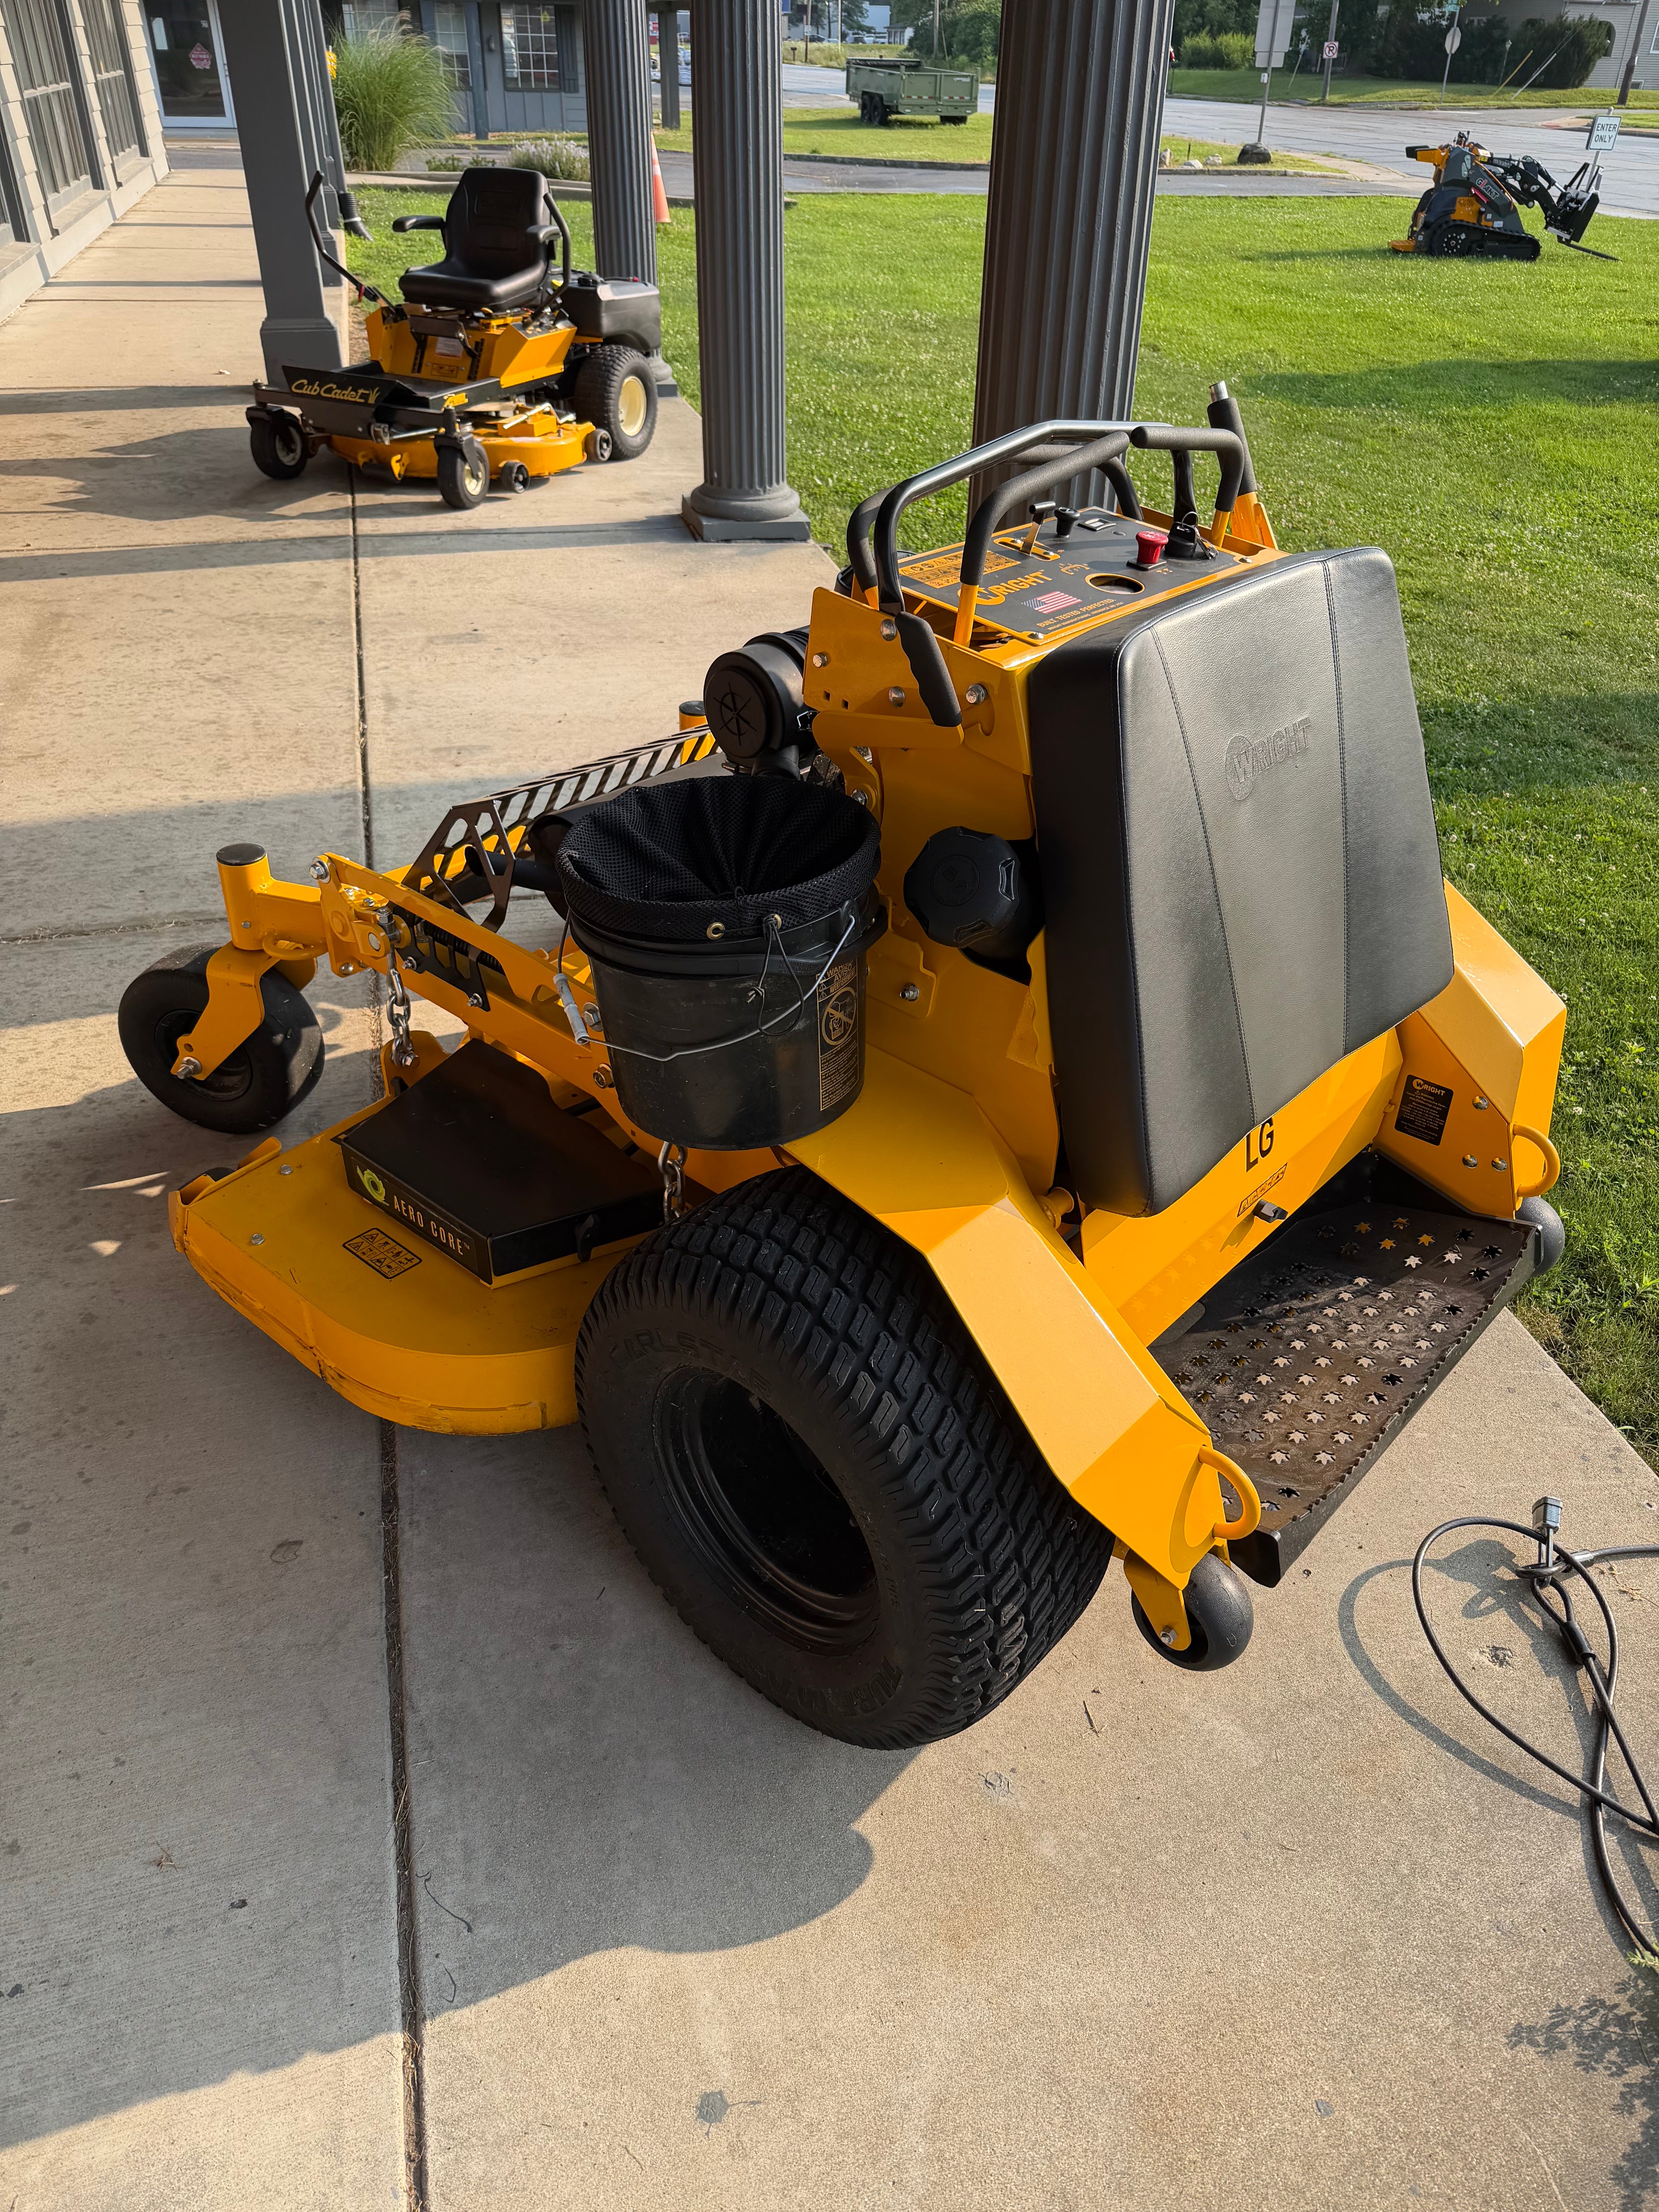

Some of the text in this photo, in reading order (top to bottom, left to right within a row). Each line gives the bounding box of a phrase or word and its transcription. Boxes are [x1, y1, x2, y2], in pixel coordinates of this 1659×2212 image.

[1595, 134, 1613, 143] ONLY
[1596, 123, 1617, 132] ENTER
[1476, 178, 1500, 200] GIANT
[291, 379, 369, 403] Cub Cadet
[1036, 599, 1116, 627] BUILT. TESTED. PERFECTED.
[1225, 716, 1311, 800] WRIGHT
[834, 963, 852, 983] AVISO
[1412, 1079, 1446, 1096] WRIGHT
[1246, 1117, 1274, 1173] LG
[394, 1195, 424, 1228] AERO
